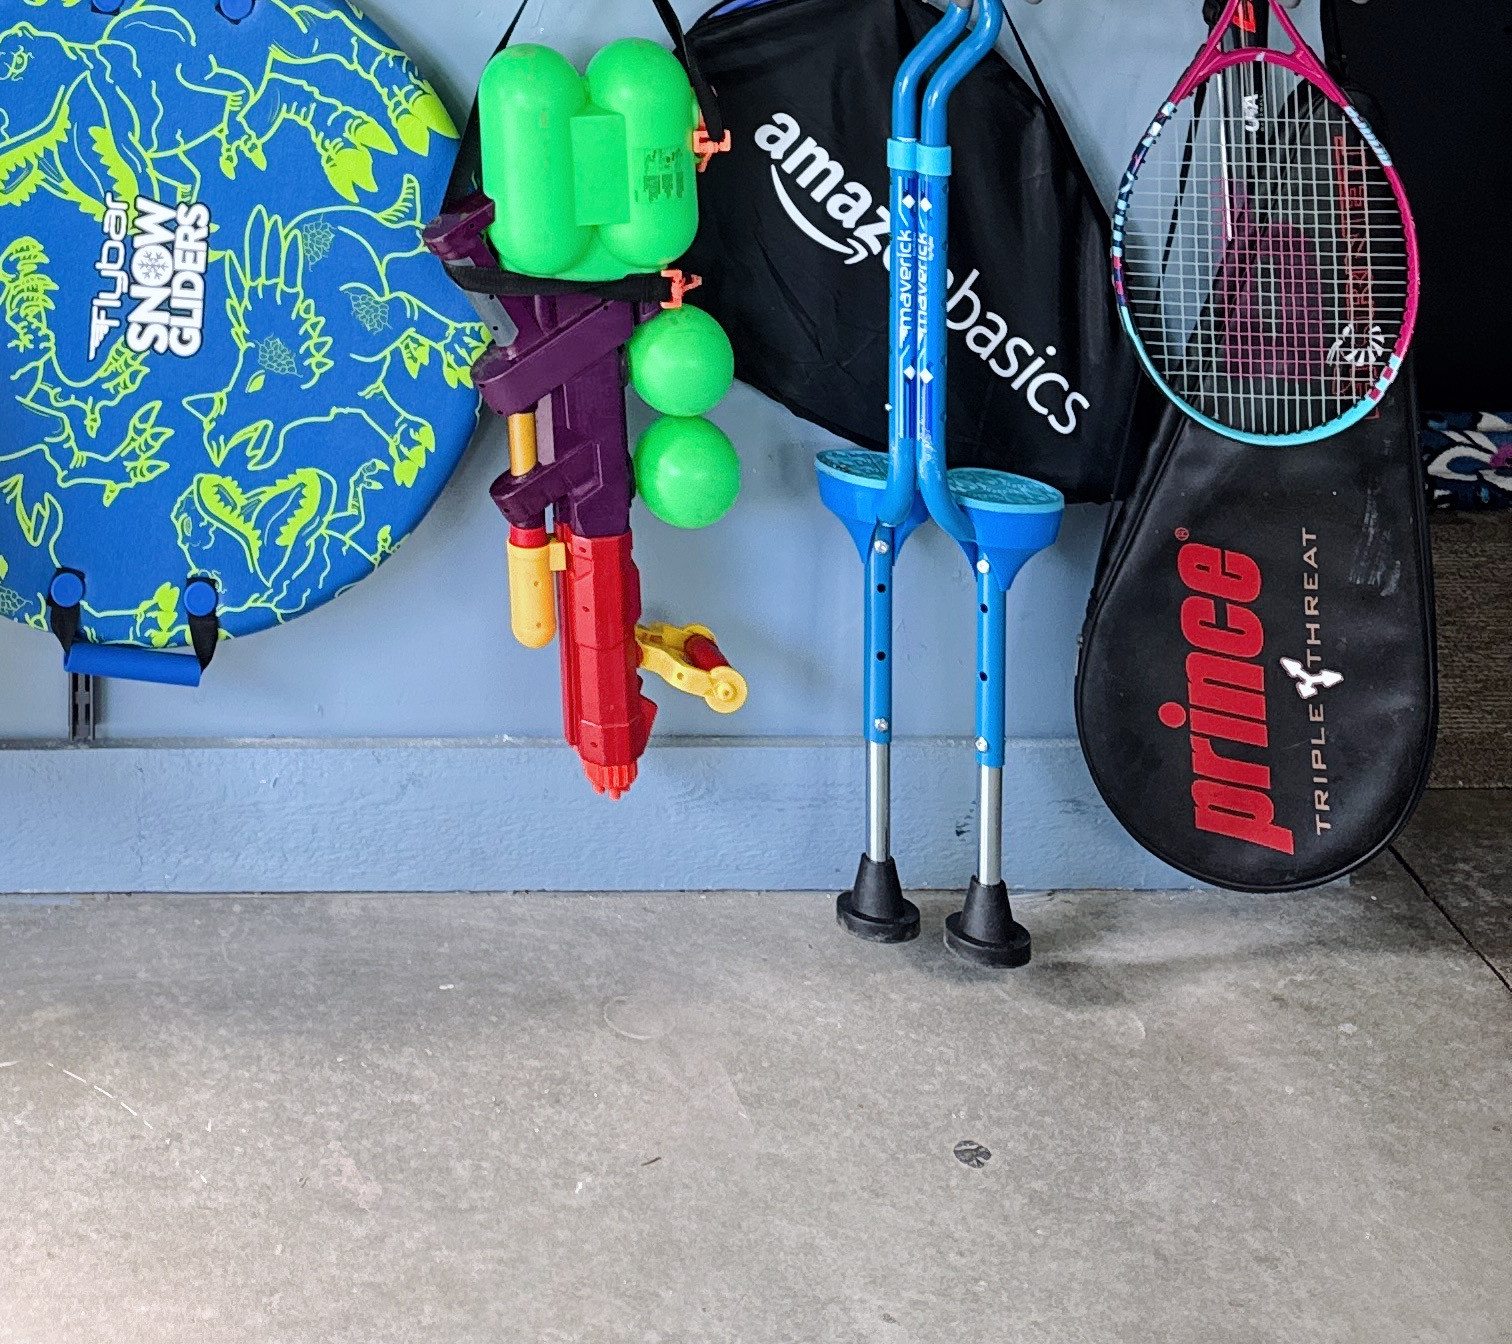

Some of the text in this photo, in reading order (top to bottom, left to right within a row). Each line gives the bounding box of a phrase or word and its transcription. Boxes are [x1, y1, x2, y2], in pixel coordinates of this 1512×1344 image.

[754, 113, 892, 271] amaz
[89, 191, 130, 360] Flybar
[126, 196, 178, 354] SNOW
[168, 202, 210, 357] GLIDERS
[897, 229, 912, 332] maverick
[917, 232, 928, 333] maverick
[1158, 542, 1294, 855] prince
[1301, 527, 1331, 836] TRIPLE THREAT
